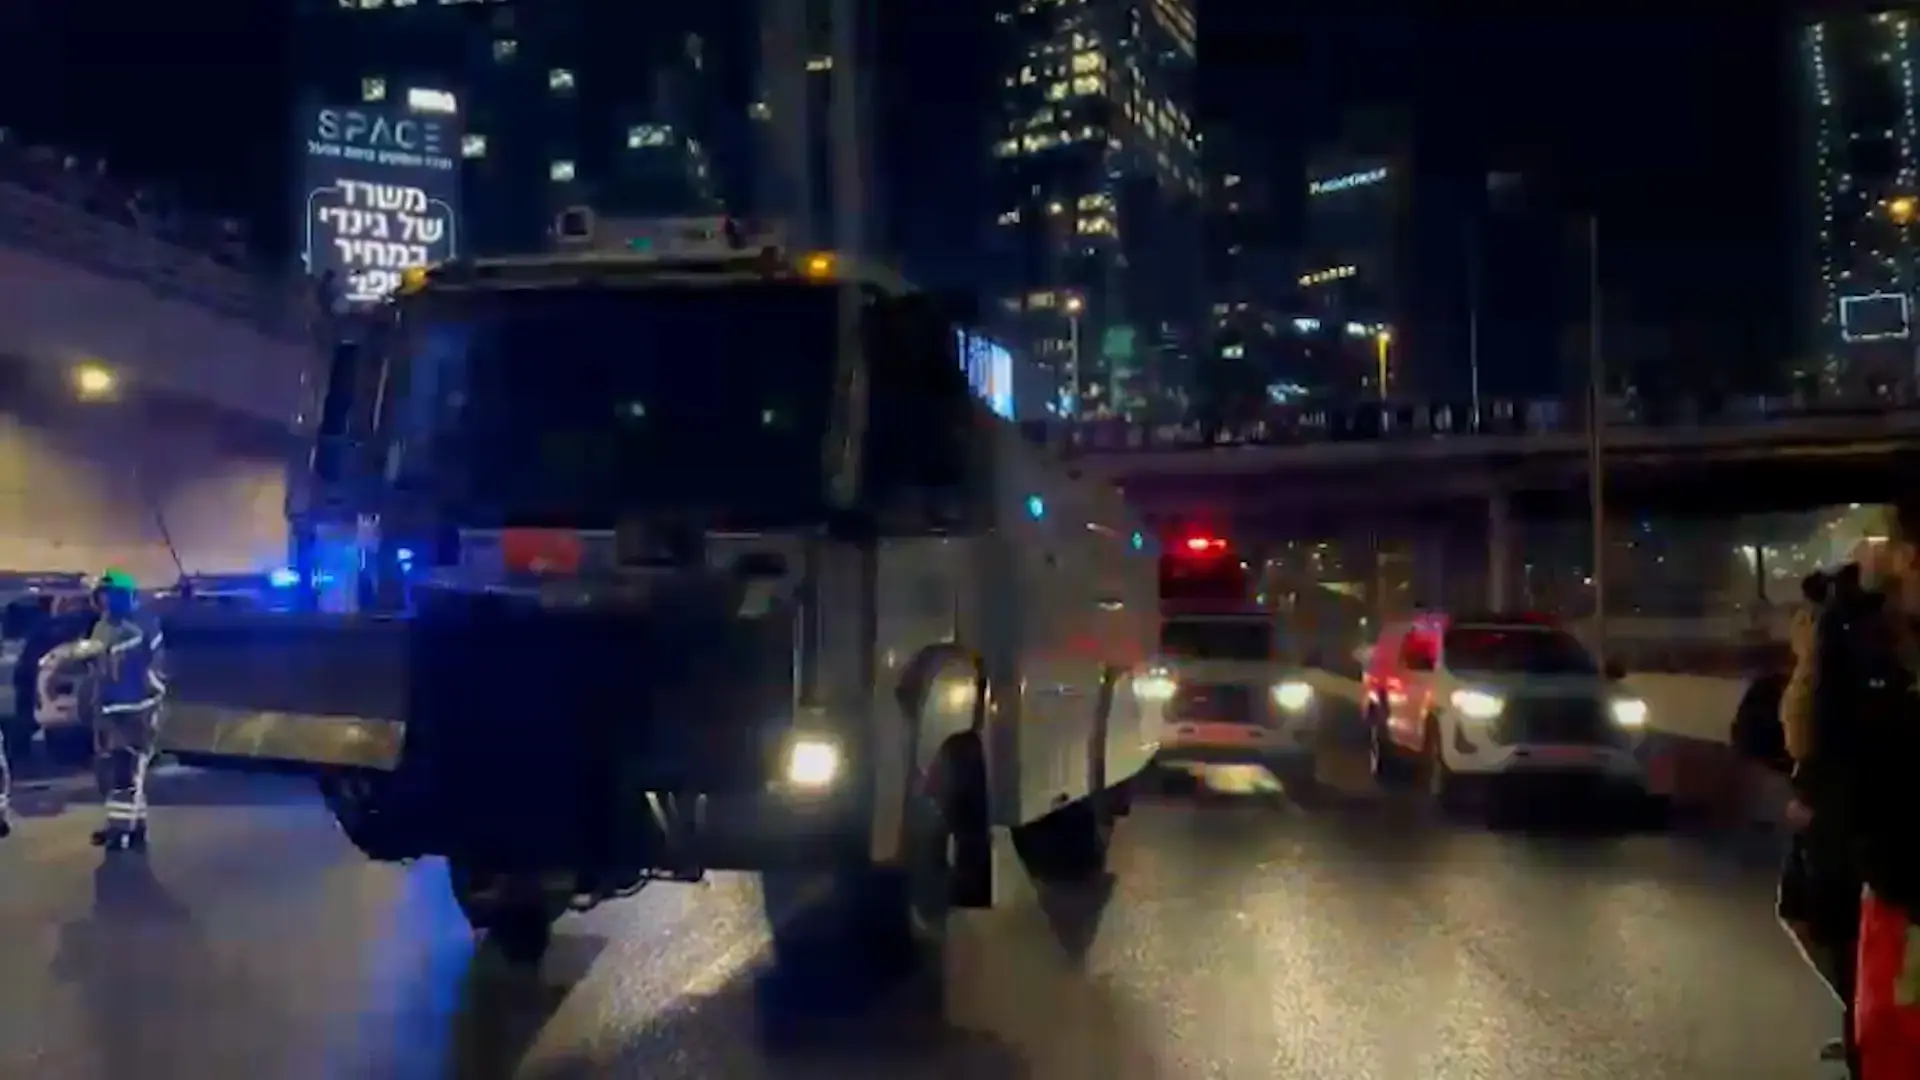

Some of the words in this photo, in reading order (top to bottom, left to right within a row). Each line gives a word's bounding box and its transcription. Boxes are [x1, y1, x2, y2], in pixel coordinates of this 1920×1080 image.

[318, 109, 441, 153] SPACE
[336, 178, 428, 212] משרד
[319, 207, 389, 238] גינדי
[397, 211, 444, 242] של
